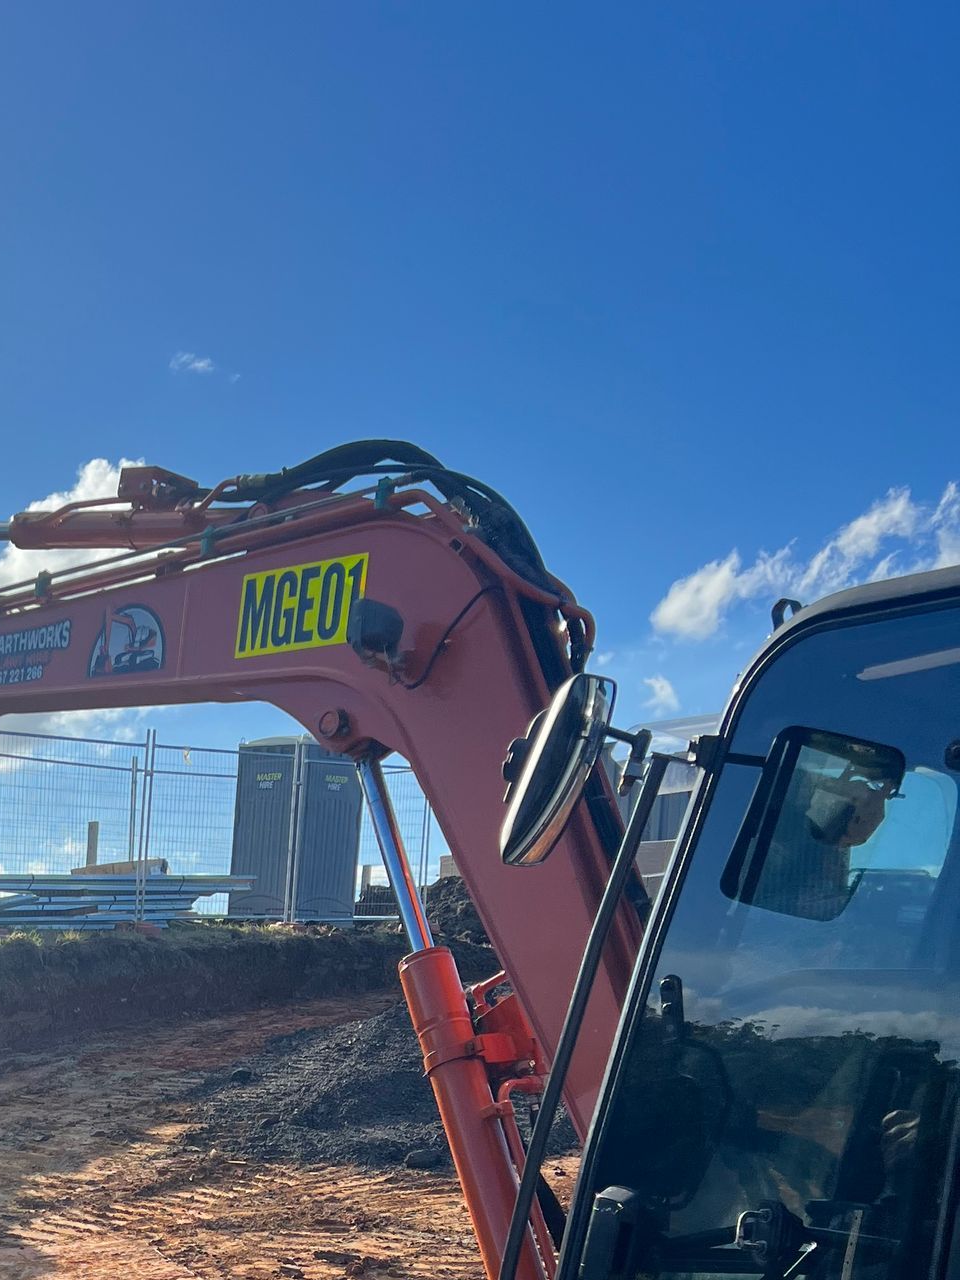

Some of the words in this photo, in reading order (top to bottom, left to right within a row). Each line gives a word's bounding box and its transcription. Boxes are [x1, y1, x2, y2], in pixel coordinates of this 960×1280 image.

[9, 666, 25, 683] 221
[256, 772, 282, 781] MASTER
[259, 780, 274, 789] HIRE
